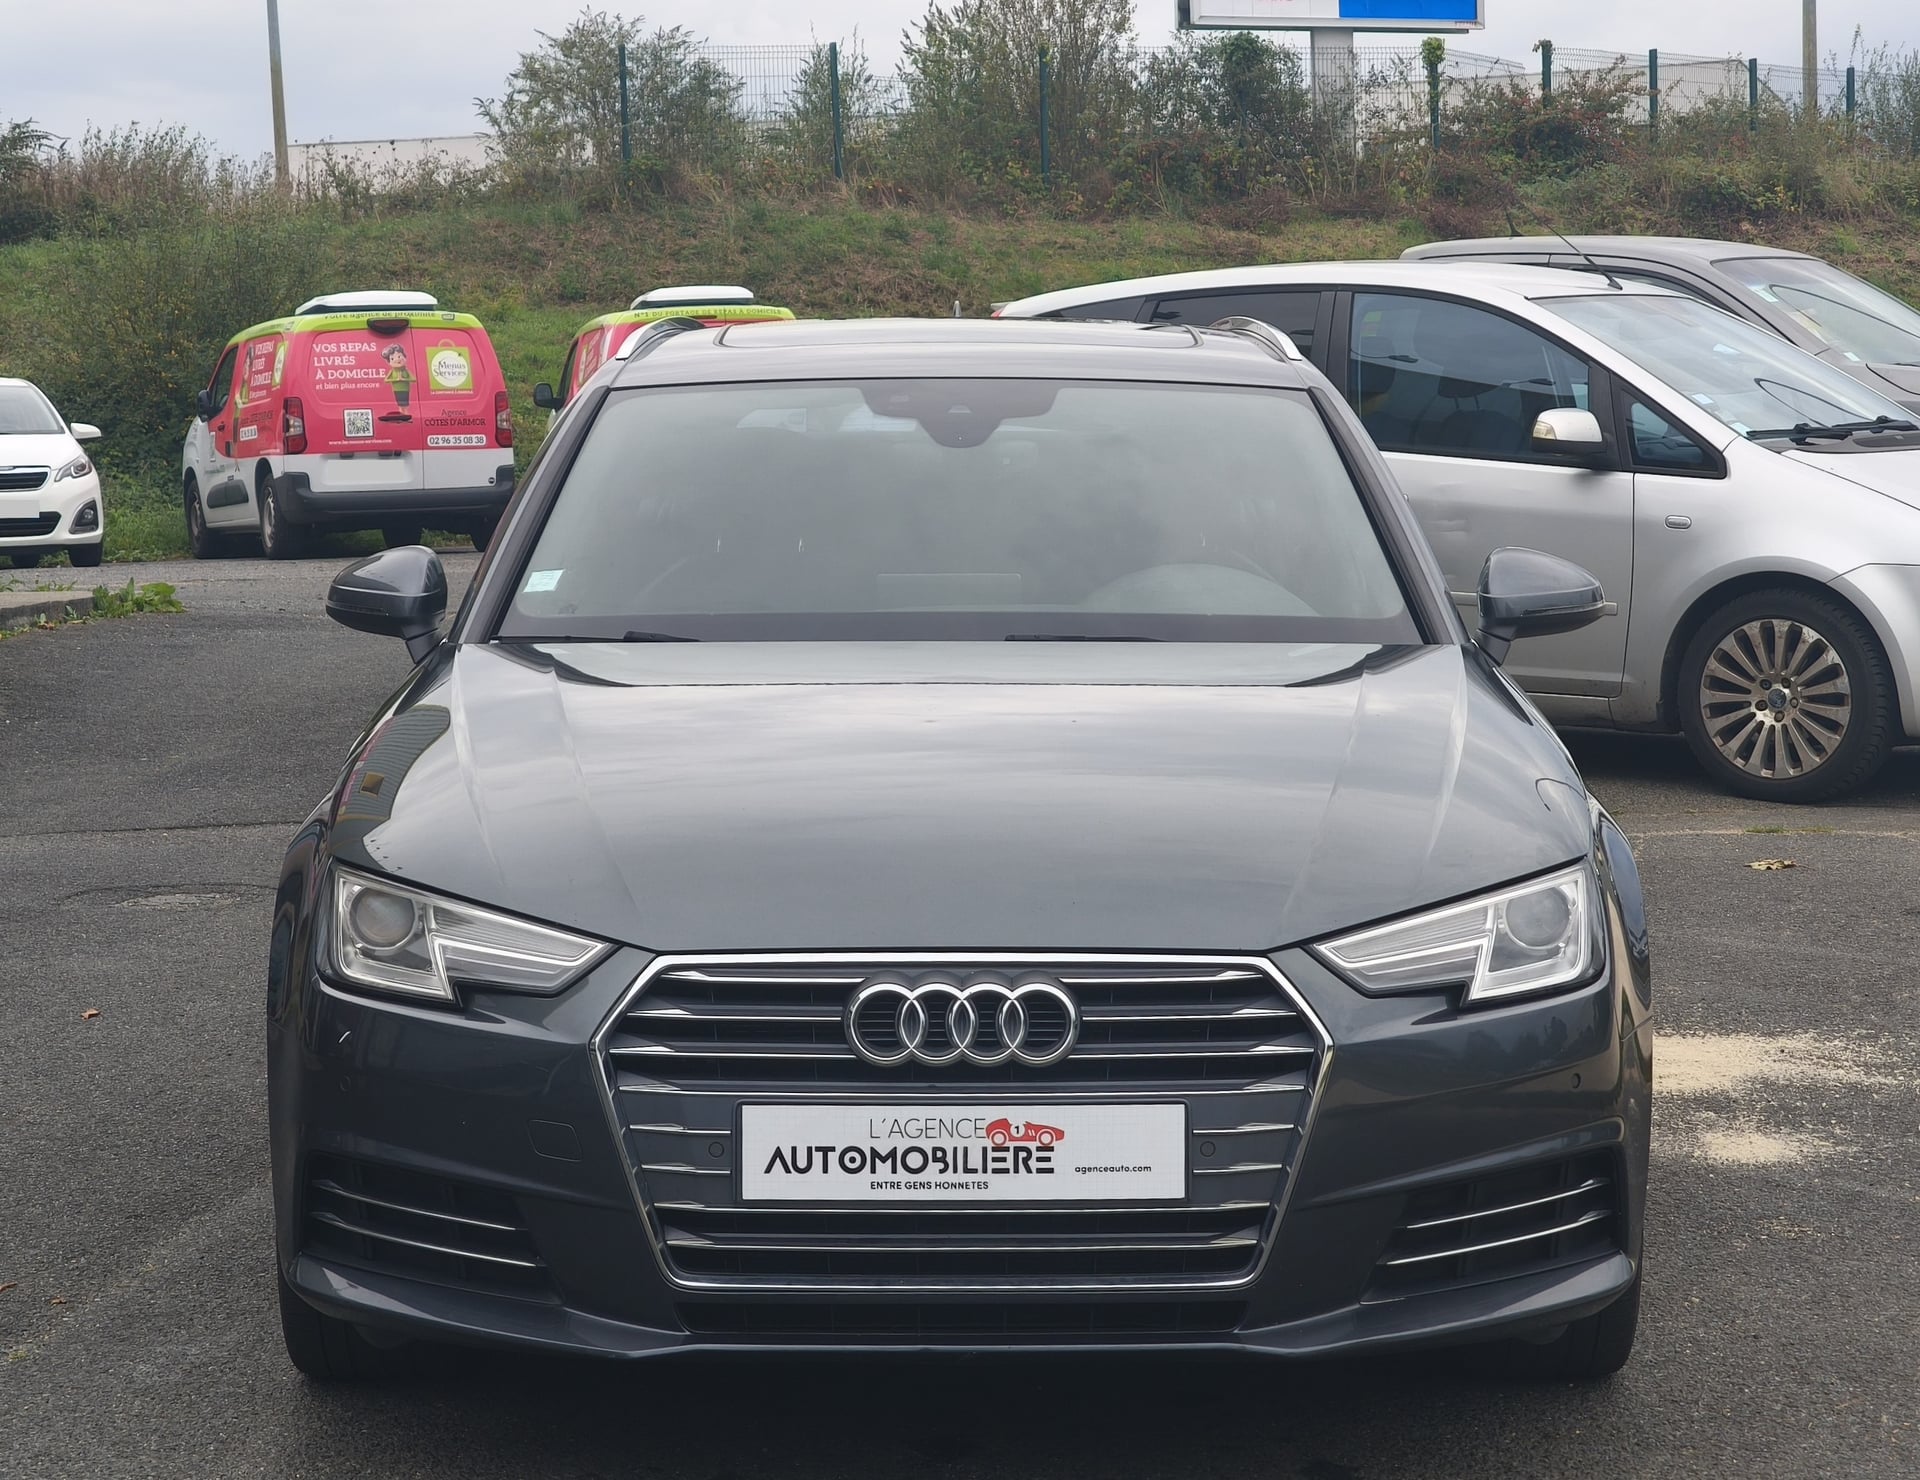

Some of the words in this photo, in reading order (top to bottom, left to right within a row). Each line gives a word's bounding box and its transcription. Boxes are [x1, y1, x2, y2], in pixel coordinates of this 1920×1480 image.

[312, 343, 337, 353] VOS
[339, 342, 377, 352] REPAS
[314, 354, 356, 366] LIVRÉS
[438, 360, 466, 369] Menus
[327, 368, 386, 379] DOMICILE
[433, 368, 467, 377] Services
[341, 382, 356, 390] plus
[450, 418, 486, 426] D'ARMOR
[429, 436, 440, 445] 02
[440, 436, 451, 444] 96
[452, 436, 462, 444] 35
[463, 436, 473, 444] 08
[474, 436, 485, 444] 38
[869, 1118, 986, 1139] L'AGENCE
[1014, 1125, 1020, 1135] 1
[1074, 1164, 1152, 1175] agenceauto.com
[870, 1181, 902, 1190] ENTRE
[904, 1181, 932, 1190] GENS
